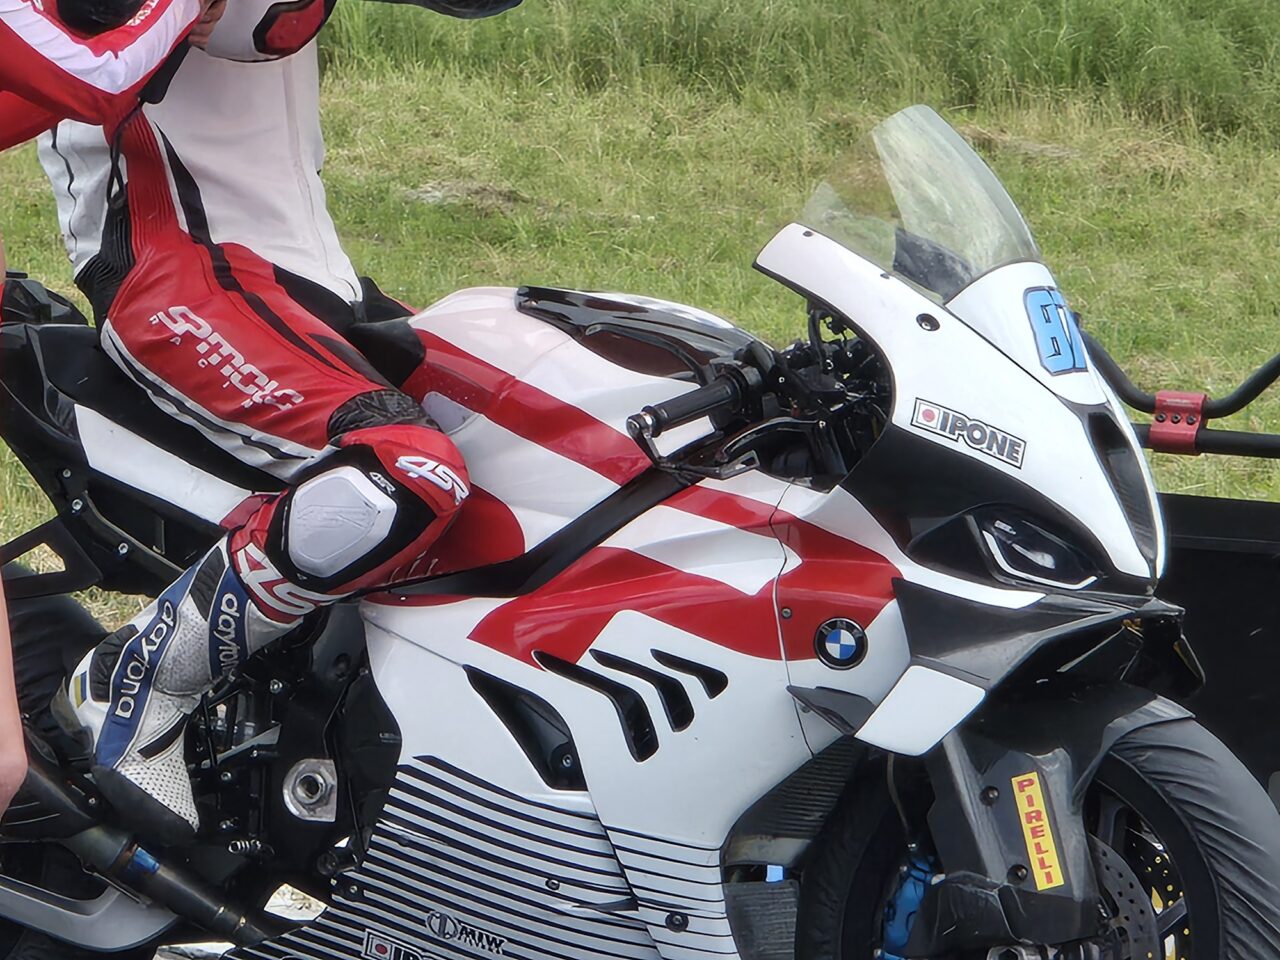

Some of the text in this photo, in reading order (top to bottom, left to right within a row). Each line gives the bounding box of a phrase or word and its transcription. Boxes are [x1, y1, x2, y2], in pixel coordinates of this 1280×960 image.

[938, 411, 1022, 464] IPONE
[114, 600, 176, 719] daytona
[1016, 777, 1054, 885] PIRELLI
